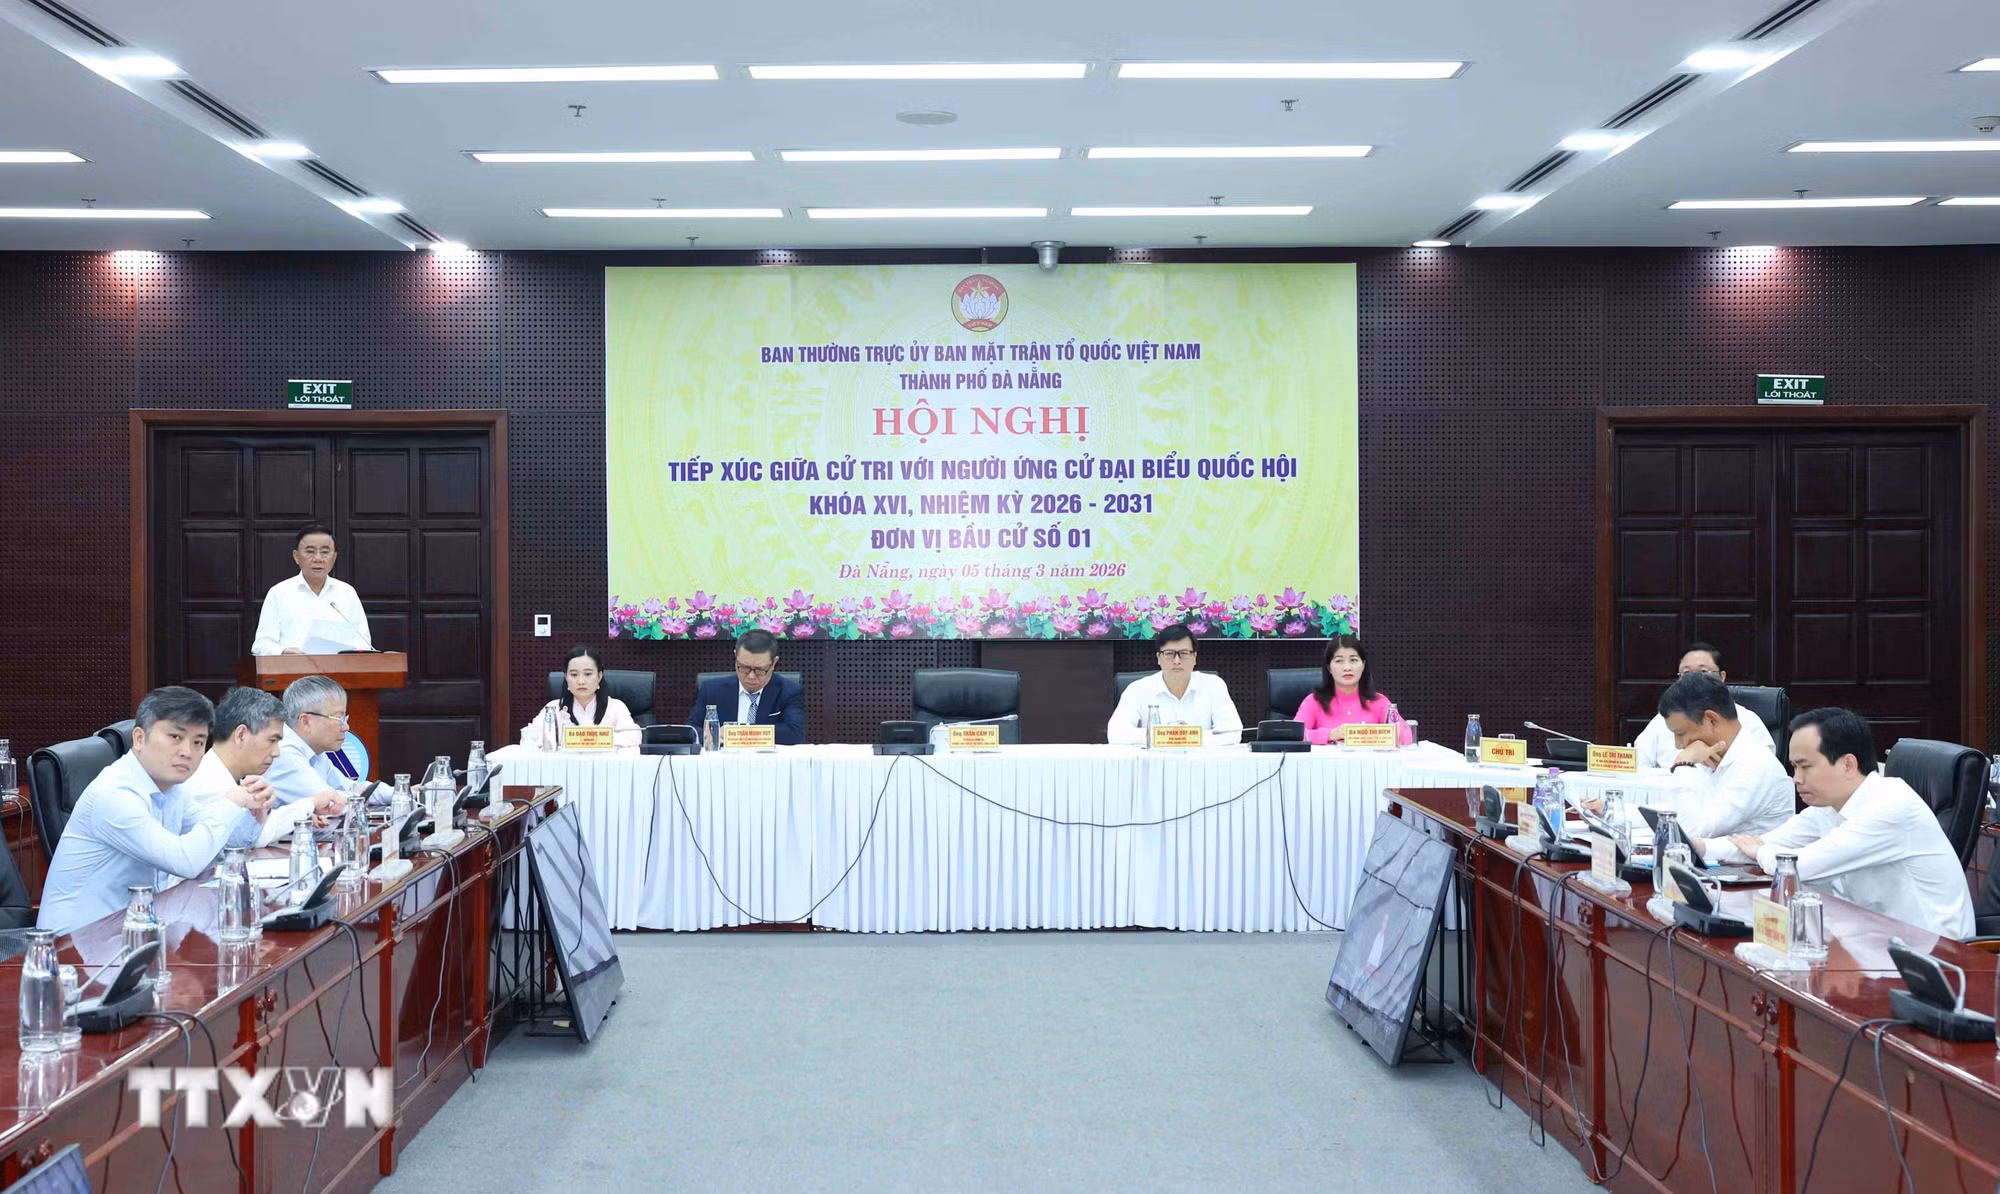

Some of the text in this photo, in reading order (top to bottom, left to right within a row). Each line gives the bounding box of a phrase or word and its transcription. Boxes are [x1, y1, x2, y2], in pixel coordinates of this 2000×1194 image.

[761, 337, 1201, 366] BAN THƯỜNG TRỰC ỦY BAN MẶT TRẬN TỔ QUỐC VIỆT NAM
[302, 383, 337, 394] EXIT
[899, 366, 1062, 391] THÀNH PHỐ ĐÀ NẴNG
[1773, 378, 1809, 389] EXIT
[312, 394, 345, 403] THOÁT
[1783, 390, 1817, 398] THOÁT
[871, 397, 1090, 445] HỘI NGHỊ
[667, 450, 1297, 484] TIẾP XÚC GIỮA CỬ TRI VỚI NGƯỜI ỨNG CỬ ĐẠI BIỂU QUỐC HỘI
[809, 491, 867, 516] KHÓA
[873, 494, 913, 518] XVI,
[920, 490, 990, 519] NHIỆM
[997, 489, 1024, 514] KỲ
[1030, 493, 1082, 514] 2026
[1103, 493, 1152, 514] 2031
[870, 521, 1091, 554] ĐƠN VỊ BẦU CỬ SỐ 01
[838, 561, 1127, 581] Đà Nẵng, ngày 05 tháng 3 năm 2026
[1491, 746, 1504, 756] CHỦ
